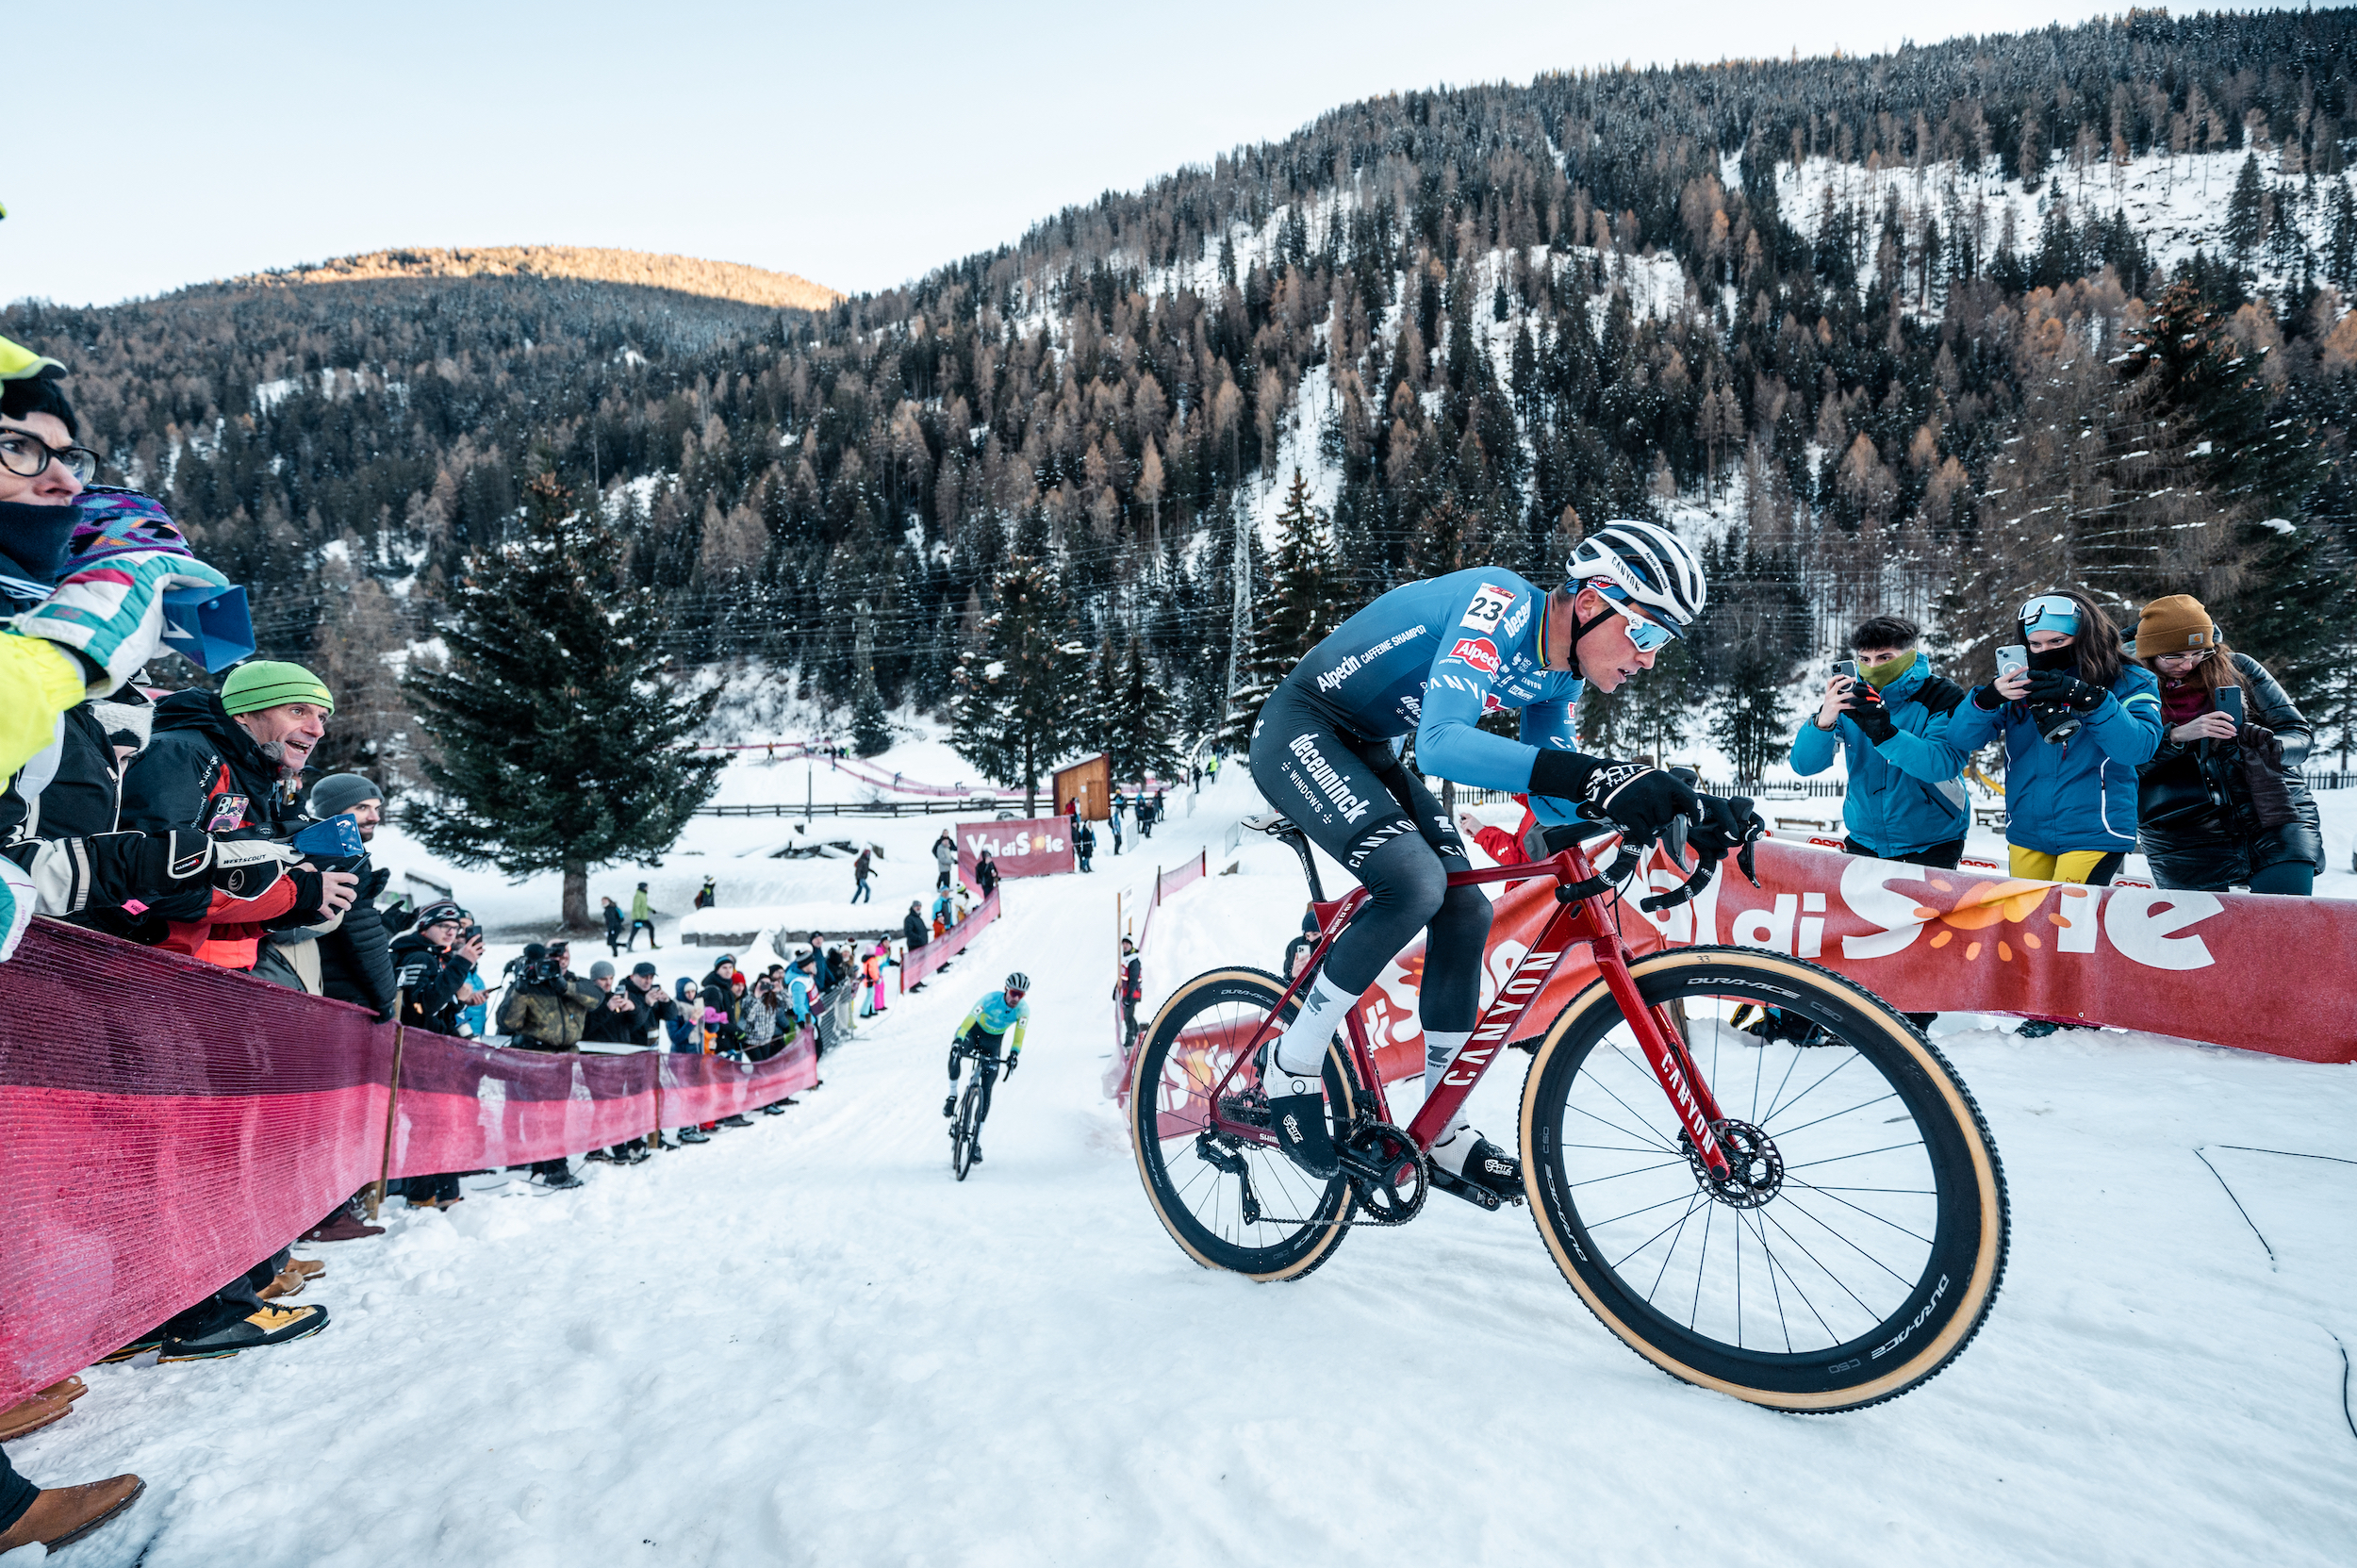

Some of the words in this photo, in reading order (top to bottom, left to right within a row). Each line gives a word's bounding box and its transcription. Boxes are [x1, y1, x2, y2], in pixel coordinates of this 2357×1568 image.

[1611, 556, 1640, 592] CANYON
[1467, 597, 1503, 621] 23
[1316, 655, 1362, 693] Alpecin
[1360, 639, 1393, 665] CAFFEINE
[1456, 642, 1500, 672] Alpecin
[1521, 677, 1541, 690] CANYON
[1289, 733, 1371, 825] deceuninck
[1289, 769, 1324, 814] WINDOWS
[1732, 893, 1826, 960] di
[1697, 955, 1711, 964] 33
[1220, 989, 1276, 1006] DURA-ACE
[1687, 977, 1802, 999] DURA-ACE
[1443, 950, 1562, 1086] CANYON
[1661, 1051, 1716, 1155] CANYON
[1485, 1159, 1514, 1172] SPATZ
[1294, 1192, 1334, 1251] DURA-ACE
[1544, 1163, 1589, 1263] DURA-ACE
[1871, 1273, 1950, 1361] DURA-ACE
[1828, 1358, 1862, 1374] C50
